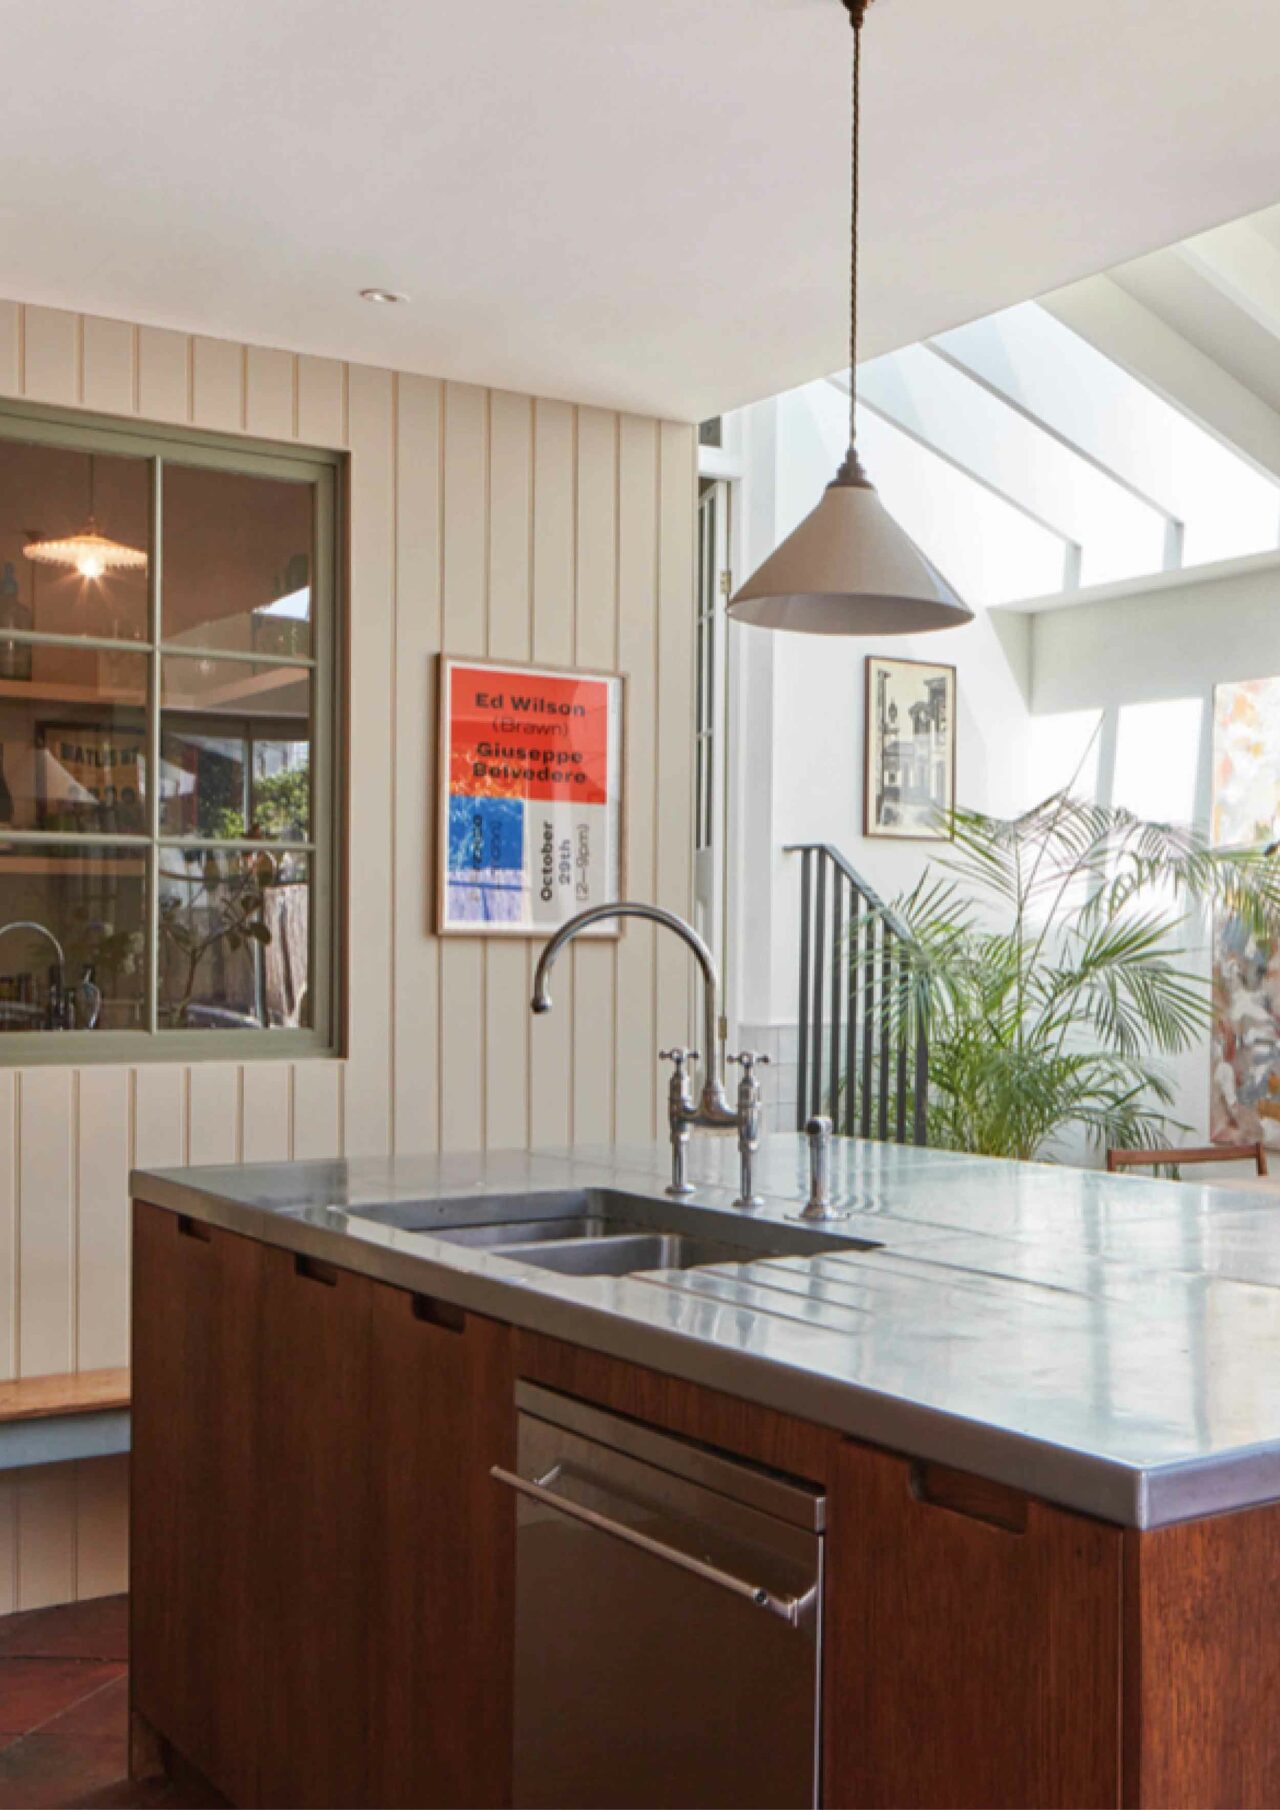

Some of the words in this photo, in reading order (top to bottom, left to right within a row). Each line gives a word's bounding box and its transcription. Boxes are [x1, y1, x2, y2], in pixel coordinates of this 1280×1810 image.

[475, 692, 504, 709] Ed
[510, 696, 585, 717] Wilson
[476, 742, 583, 765] Giuseppe
[472, 762, 587, 784] Belvedere
[540, 820, 554, 902] October
[558, 838, 571, 885] 29th
